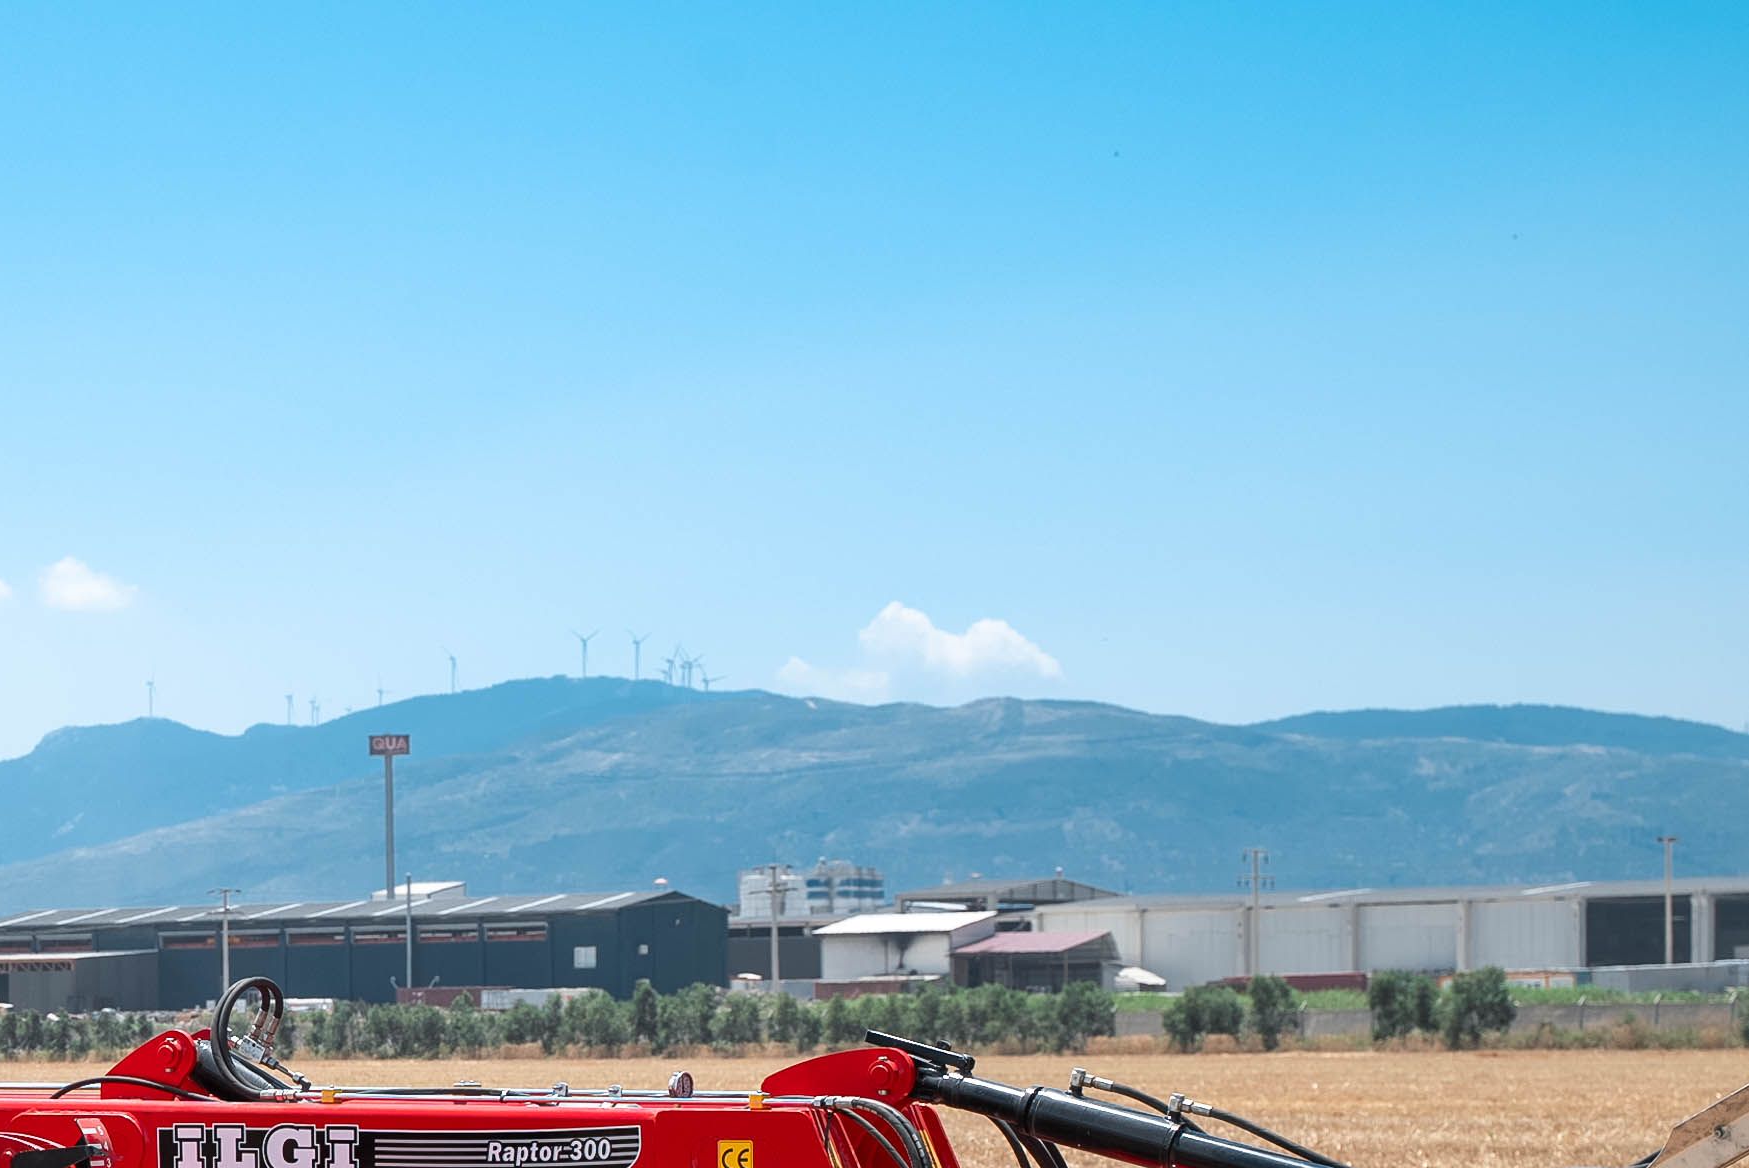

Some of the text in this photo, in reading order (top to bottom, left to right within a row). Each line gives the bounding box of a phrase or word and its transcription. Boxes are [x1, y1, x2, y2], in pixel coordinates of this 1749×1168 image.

[96, 1125, 105, 1136] 5
[103, 1141, 109, 1151] 4
[487, 1139, 611, 1167] Raptor 300
[106, 1158, 112, 1168] 3
